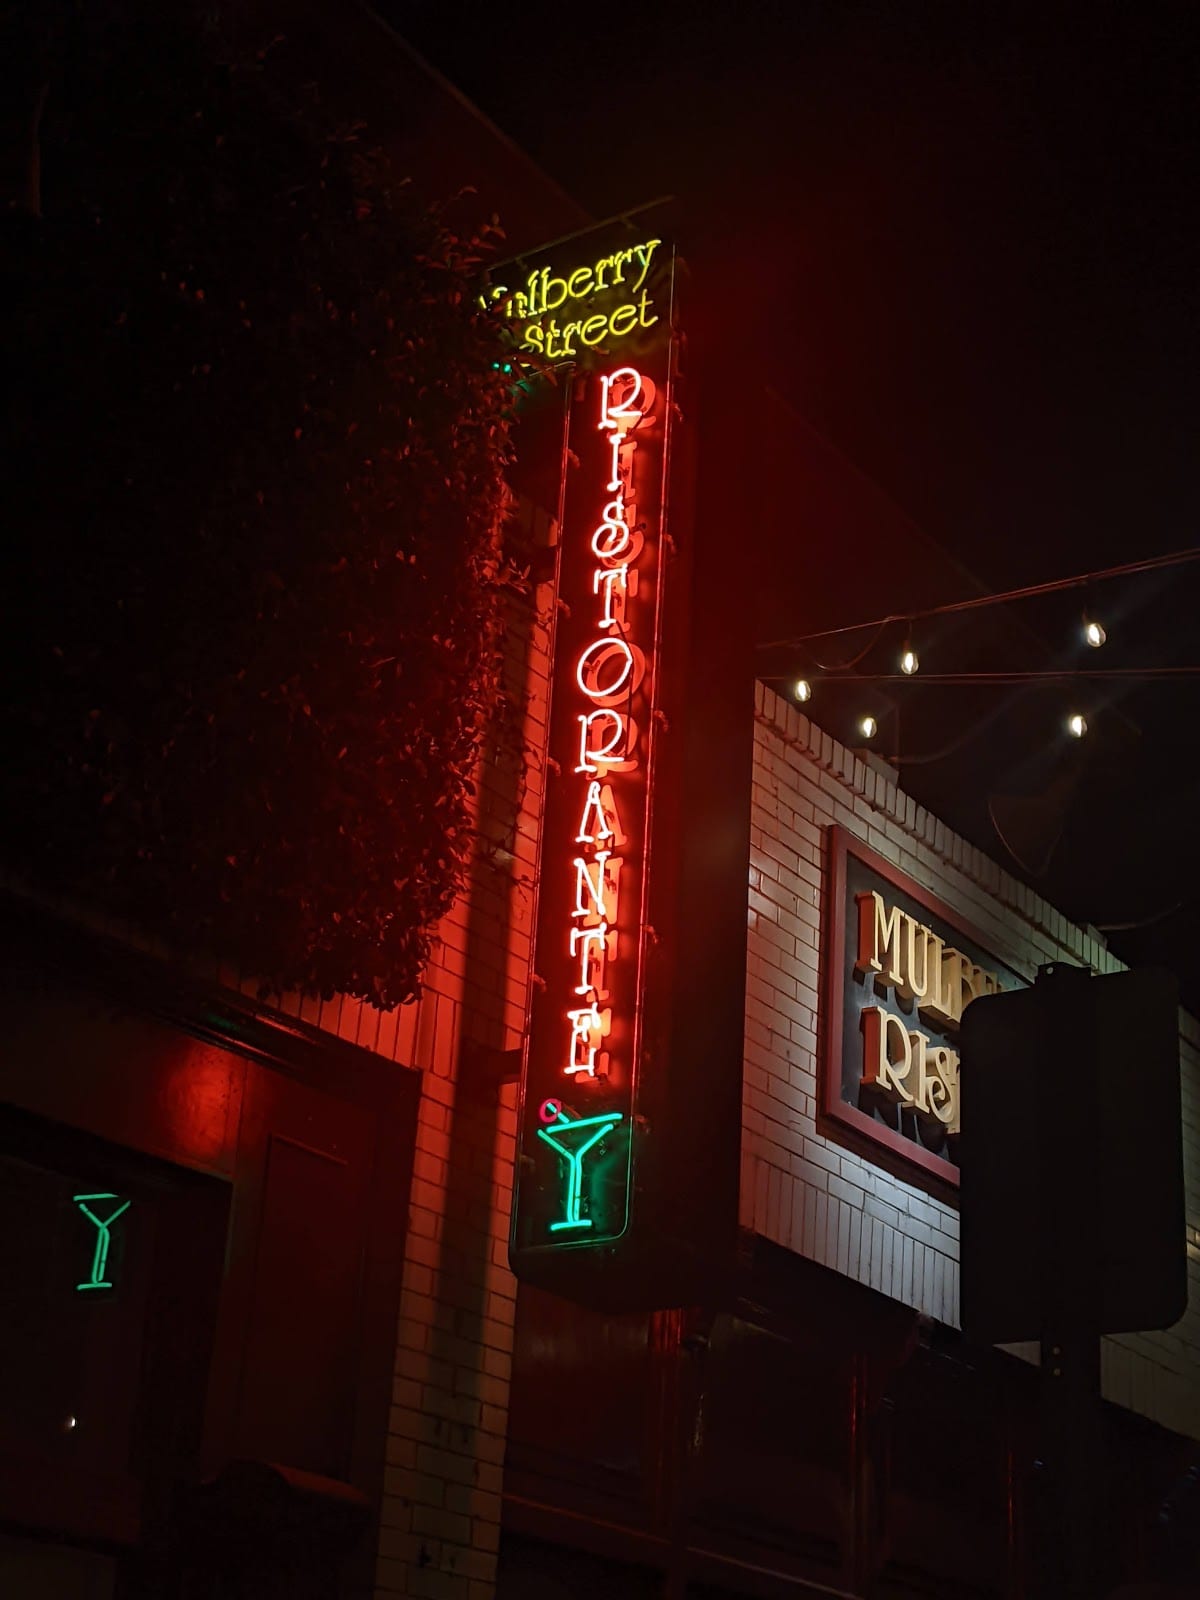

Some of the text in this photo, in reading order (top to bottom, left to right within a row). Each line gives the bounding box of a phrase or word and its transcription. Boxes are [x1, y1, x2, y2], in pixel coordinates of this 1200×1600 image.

[518, 287, 660, 358] Street
[564, 366, 648, 1079] RISTORANTE
[857, 890, 1003, 1027] MULB
